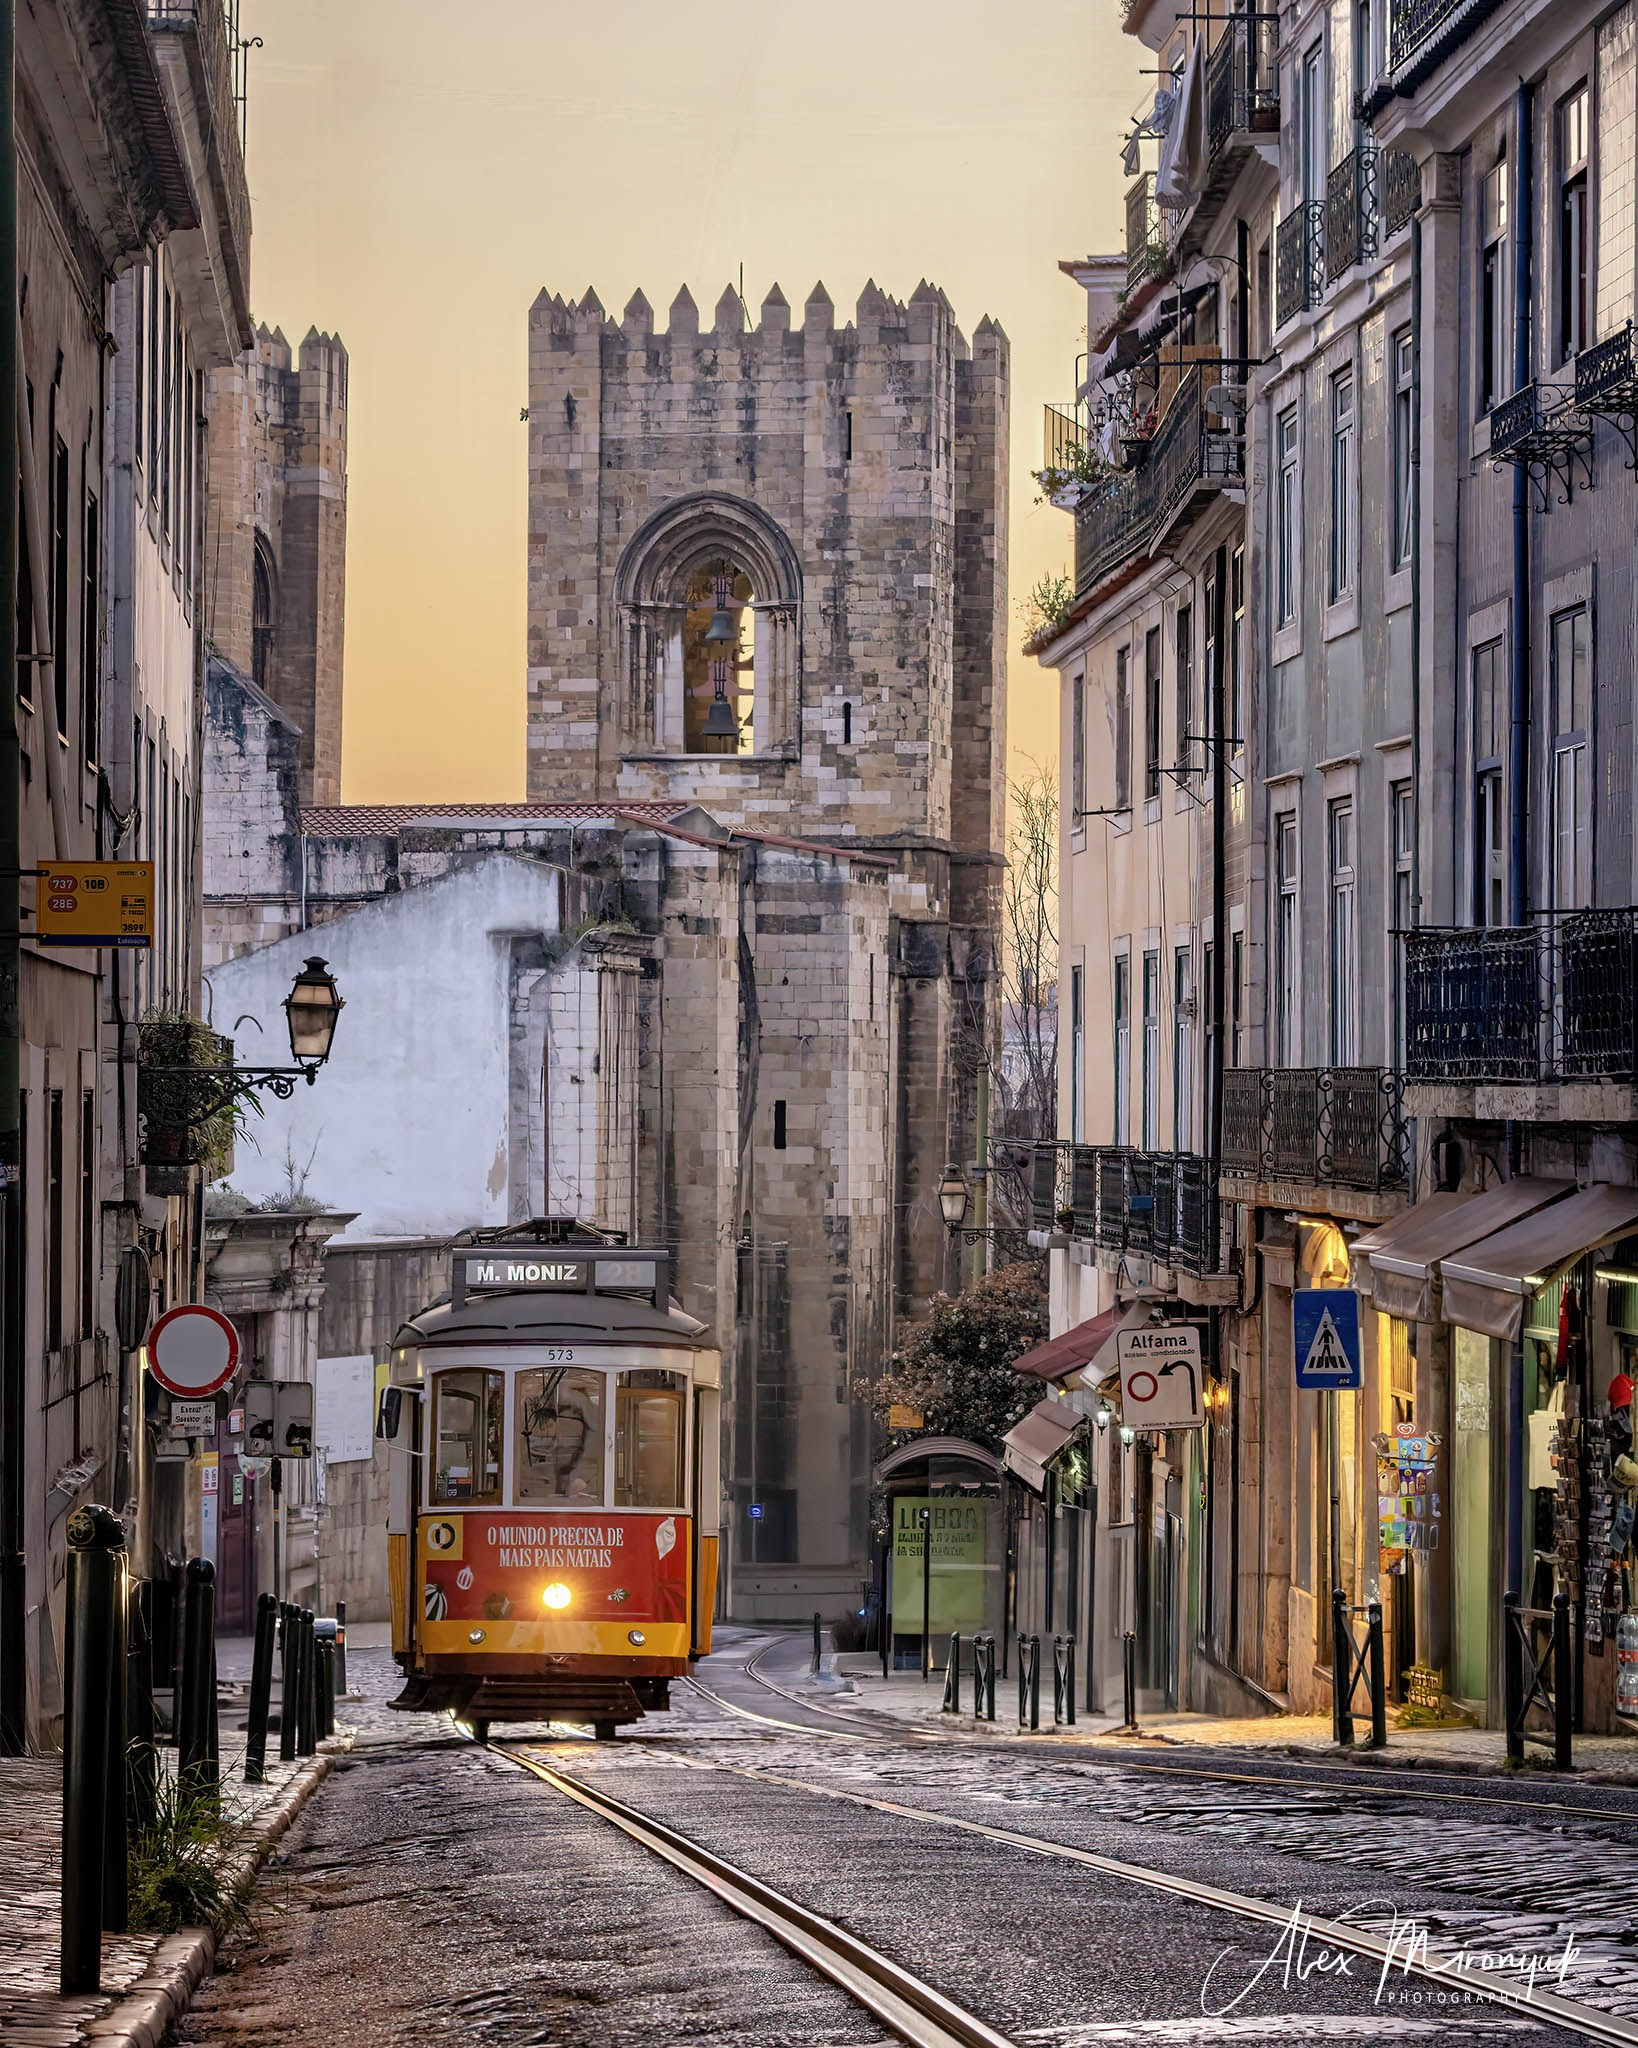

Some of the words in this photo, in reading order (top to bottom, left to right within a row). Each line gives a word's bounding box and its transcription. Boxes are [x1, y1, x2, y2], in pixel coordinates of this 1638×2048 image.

[52, 879, 73, 889] 737
[52, 898, 73, 909] 28E
[477, 1265, 500, 1282] M.
[507, 1264, 578, 1281] MONIZ
[1130, 1335, 1187, 1349] Alfama
[548, 1349, 574, 1361] 573
[487, 1526, 497, 1546] O
[499, 1527, 547, 1546] MUNDO
[550, 1527, 603, 1547] PRECISA
[607, 1528, 624, 1547] DE
[499, 1549, 532, 1567] MAIS
[534, 1548, 564, 1568] PAIS
[566, 1549, 612, 1568] NATAIS
